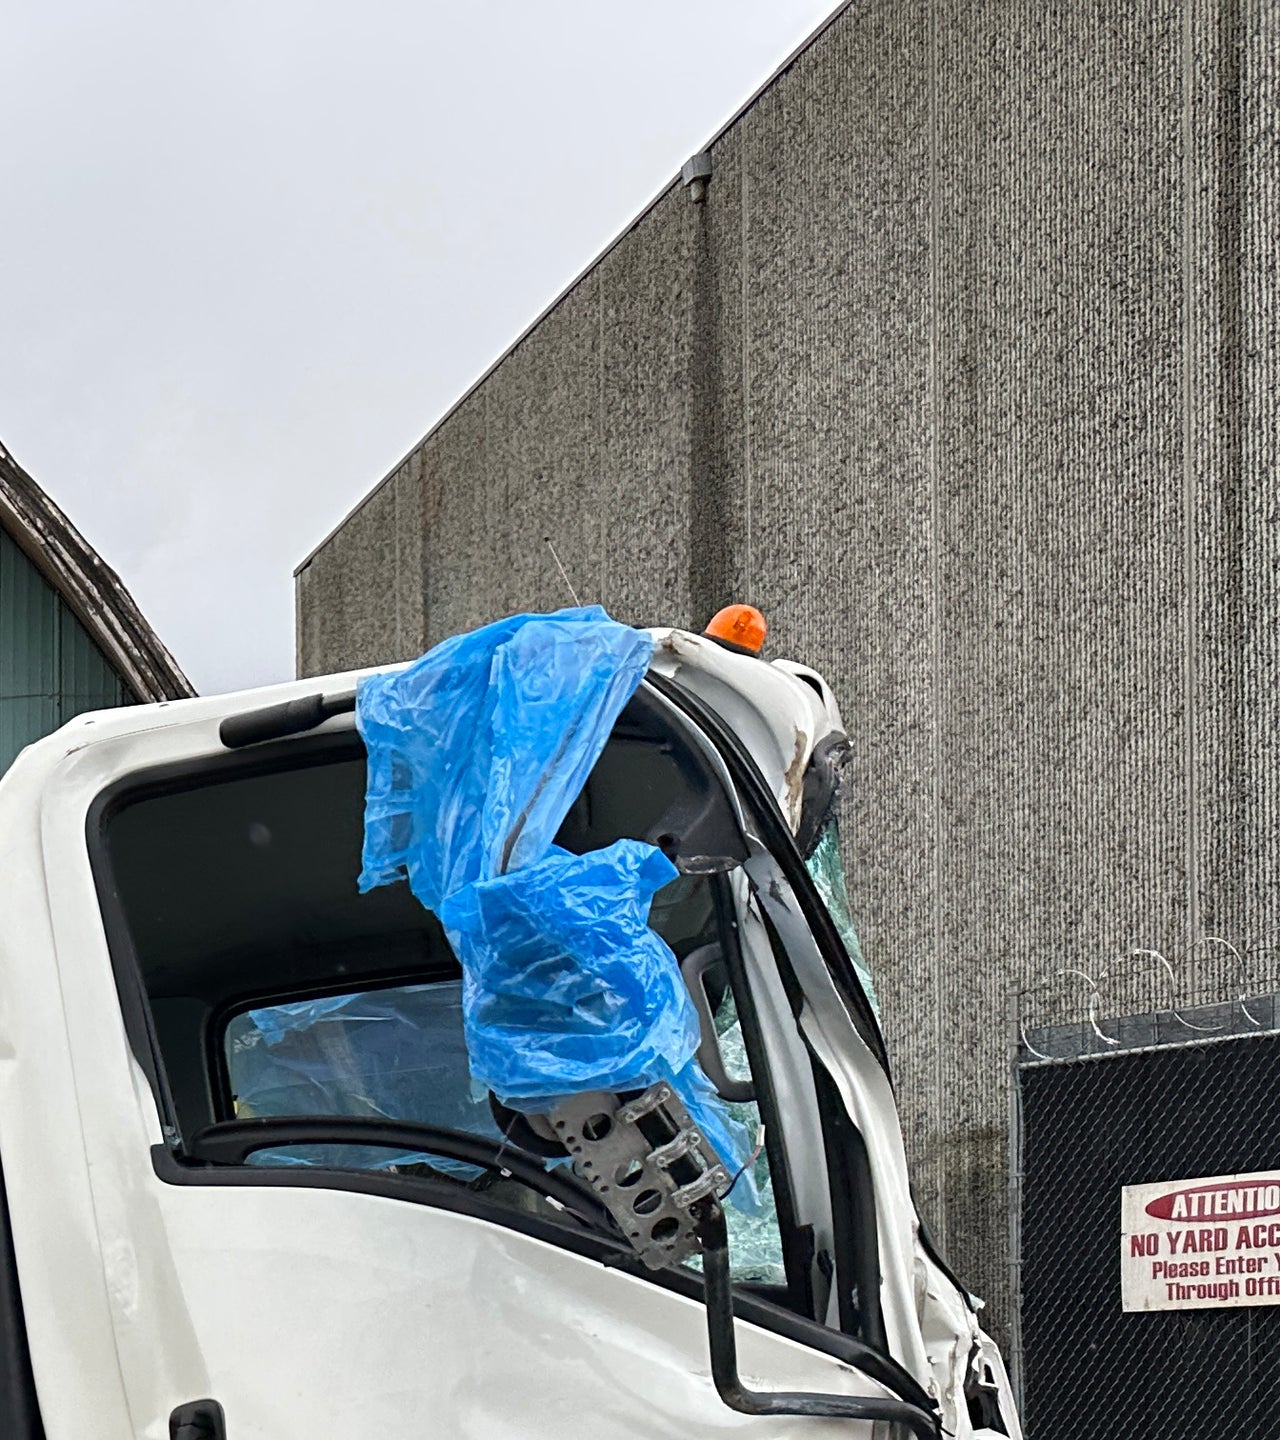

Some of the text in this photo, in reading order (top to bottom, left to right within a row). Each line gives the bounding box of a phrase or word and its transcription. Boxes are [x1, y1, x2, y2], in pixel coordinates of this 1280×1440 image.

[1171, 1186, 1280, 1218] ATTENTIO
[1130, 1223, 1280, 1258] NO YARD ACC
[1151, 1260, 1210, 1280] Please
[1215, 1255, 1268, 1275] Enter
[1166, 1275, 1280, 1301] Through Offi
